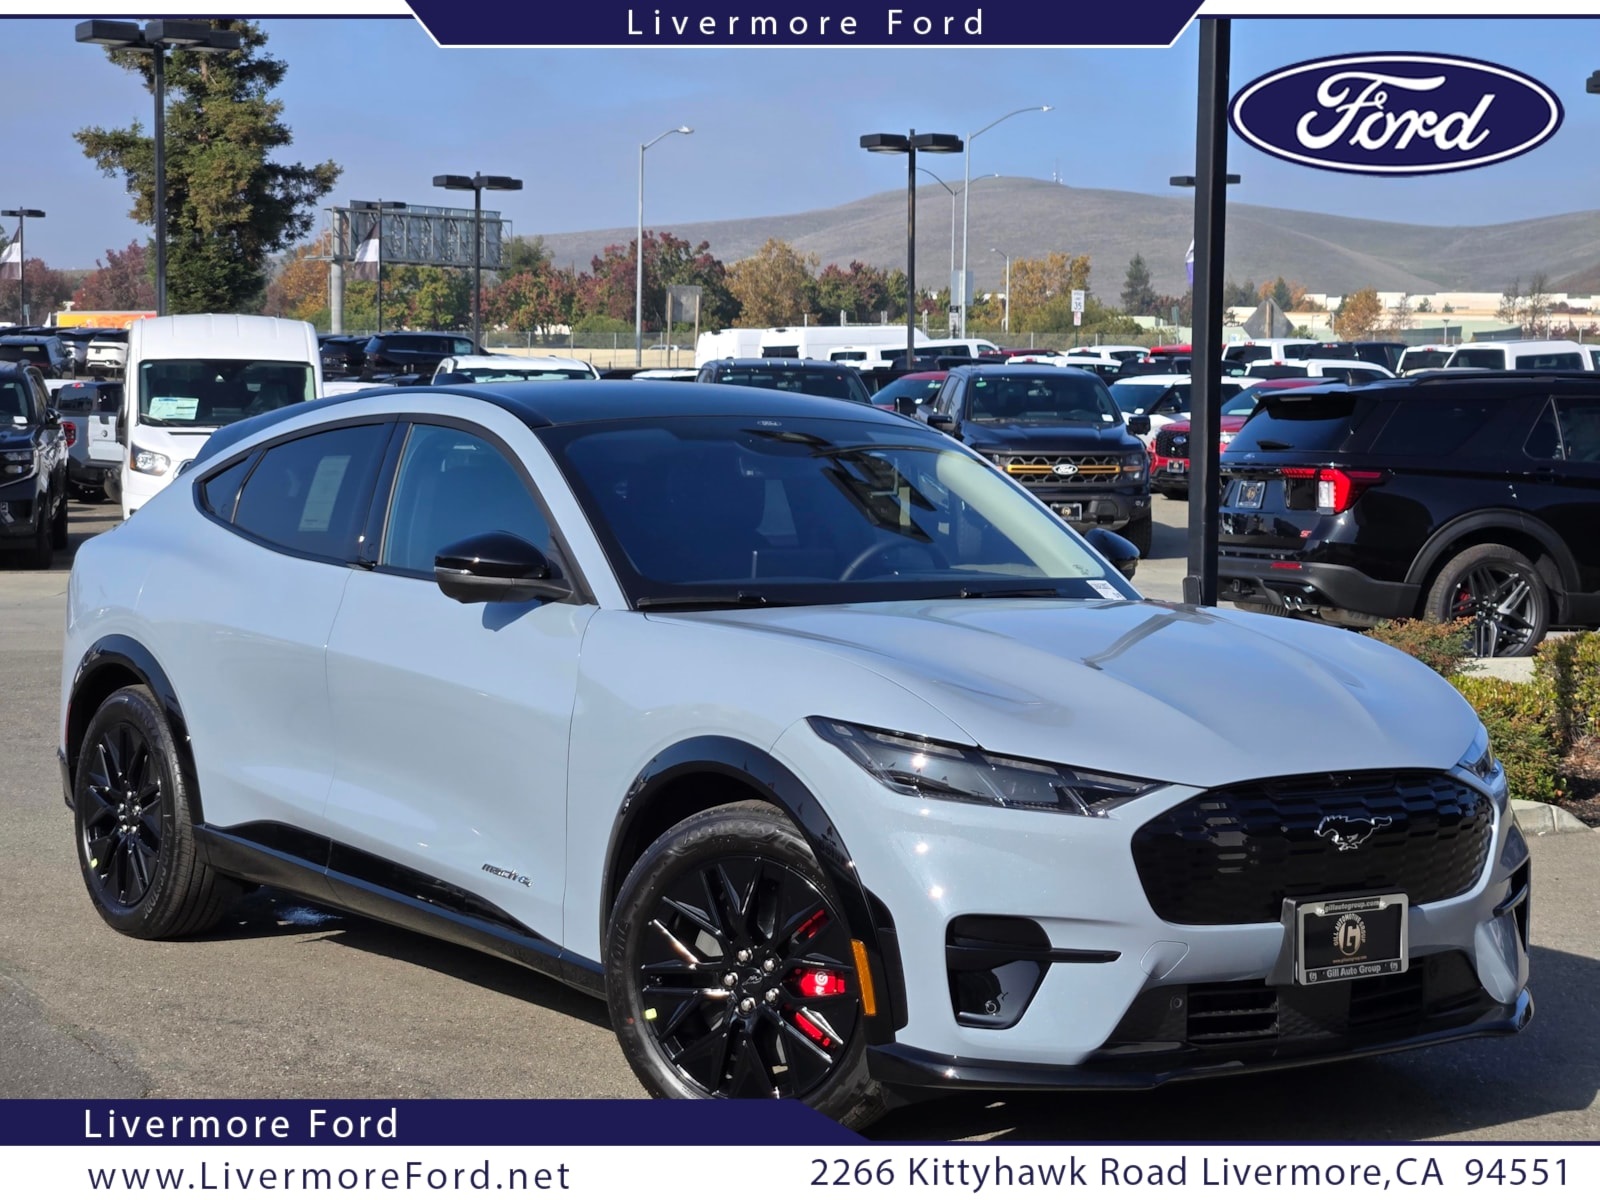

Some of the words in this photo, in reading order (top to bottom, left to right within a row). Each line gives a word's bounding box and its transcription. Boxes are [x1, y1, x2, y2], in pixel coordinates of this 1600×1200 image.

[1325, 900, 1380, 913] gillautogroup.com
[1326, 969, 1340, 978] Gill
[1340, 966, 1358, 976] Auto
[1358, 964, 1382, 974] Group
